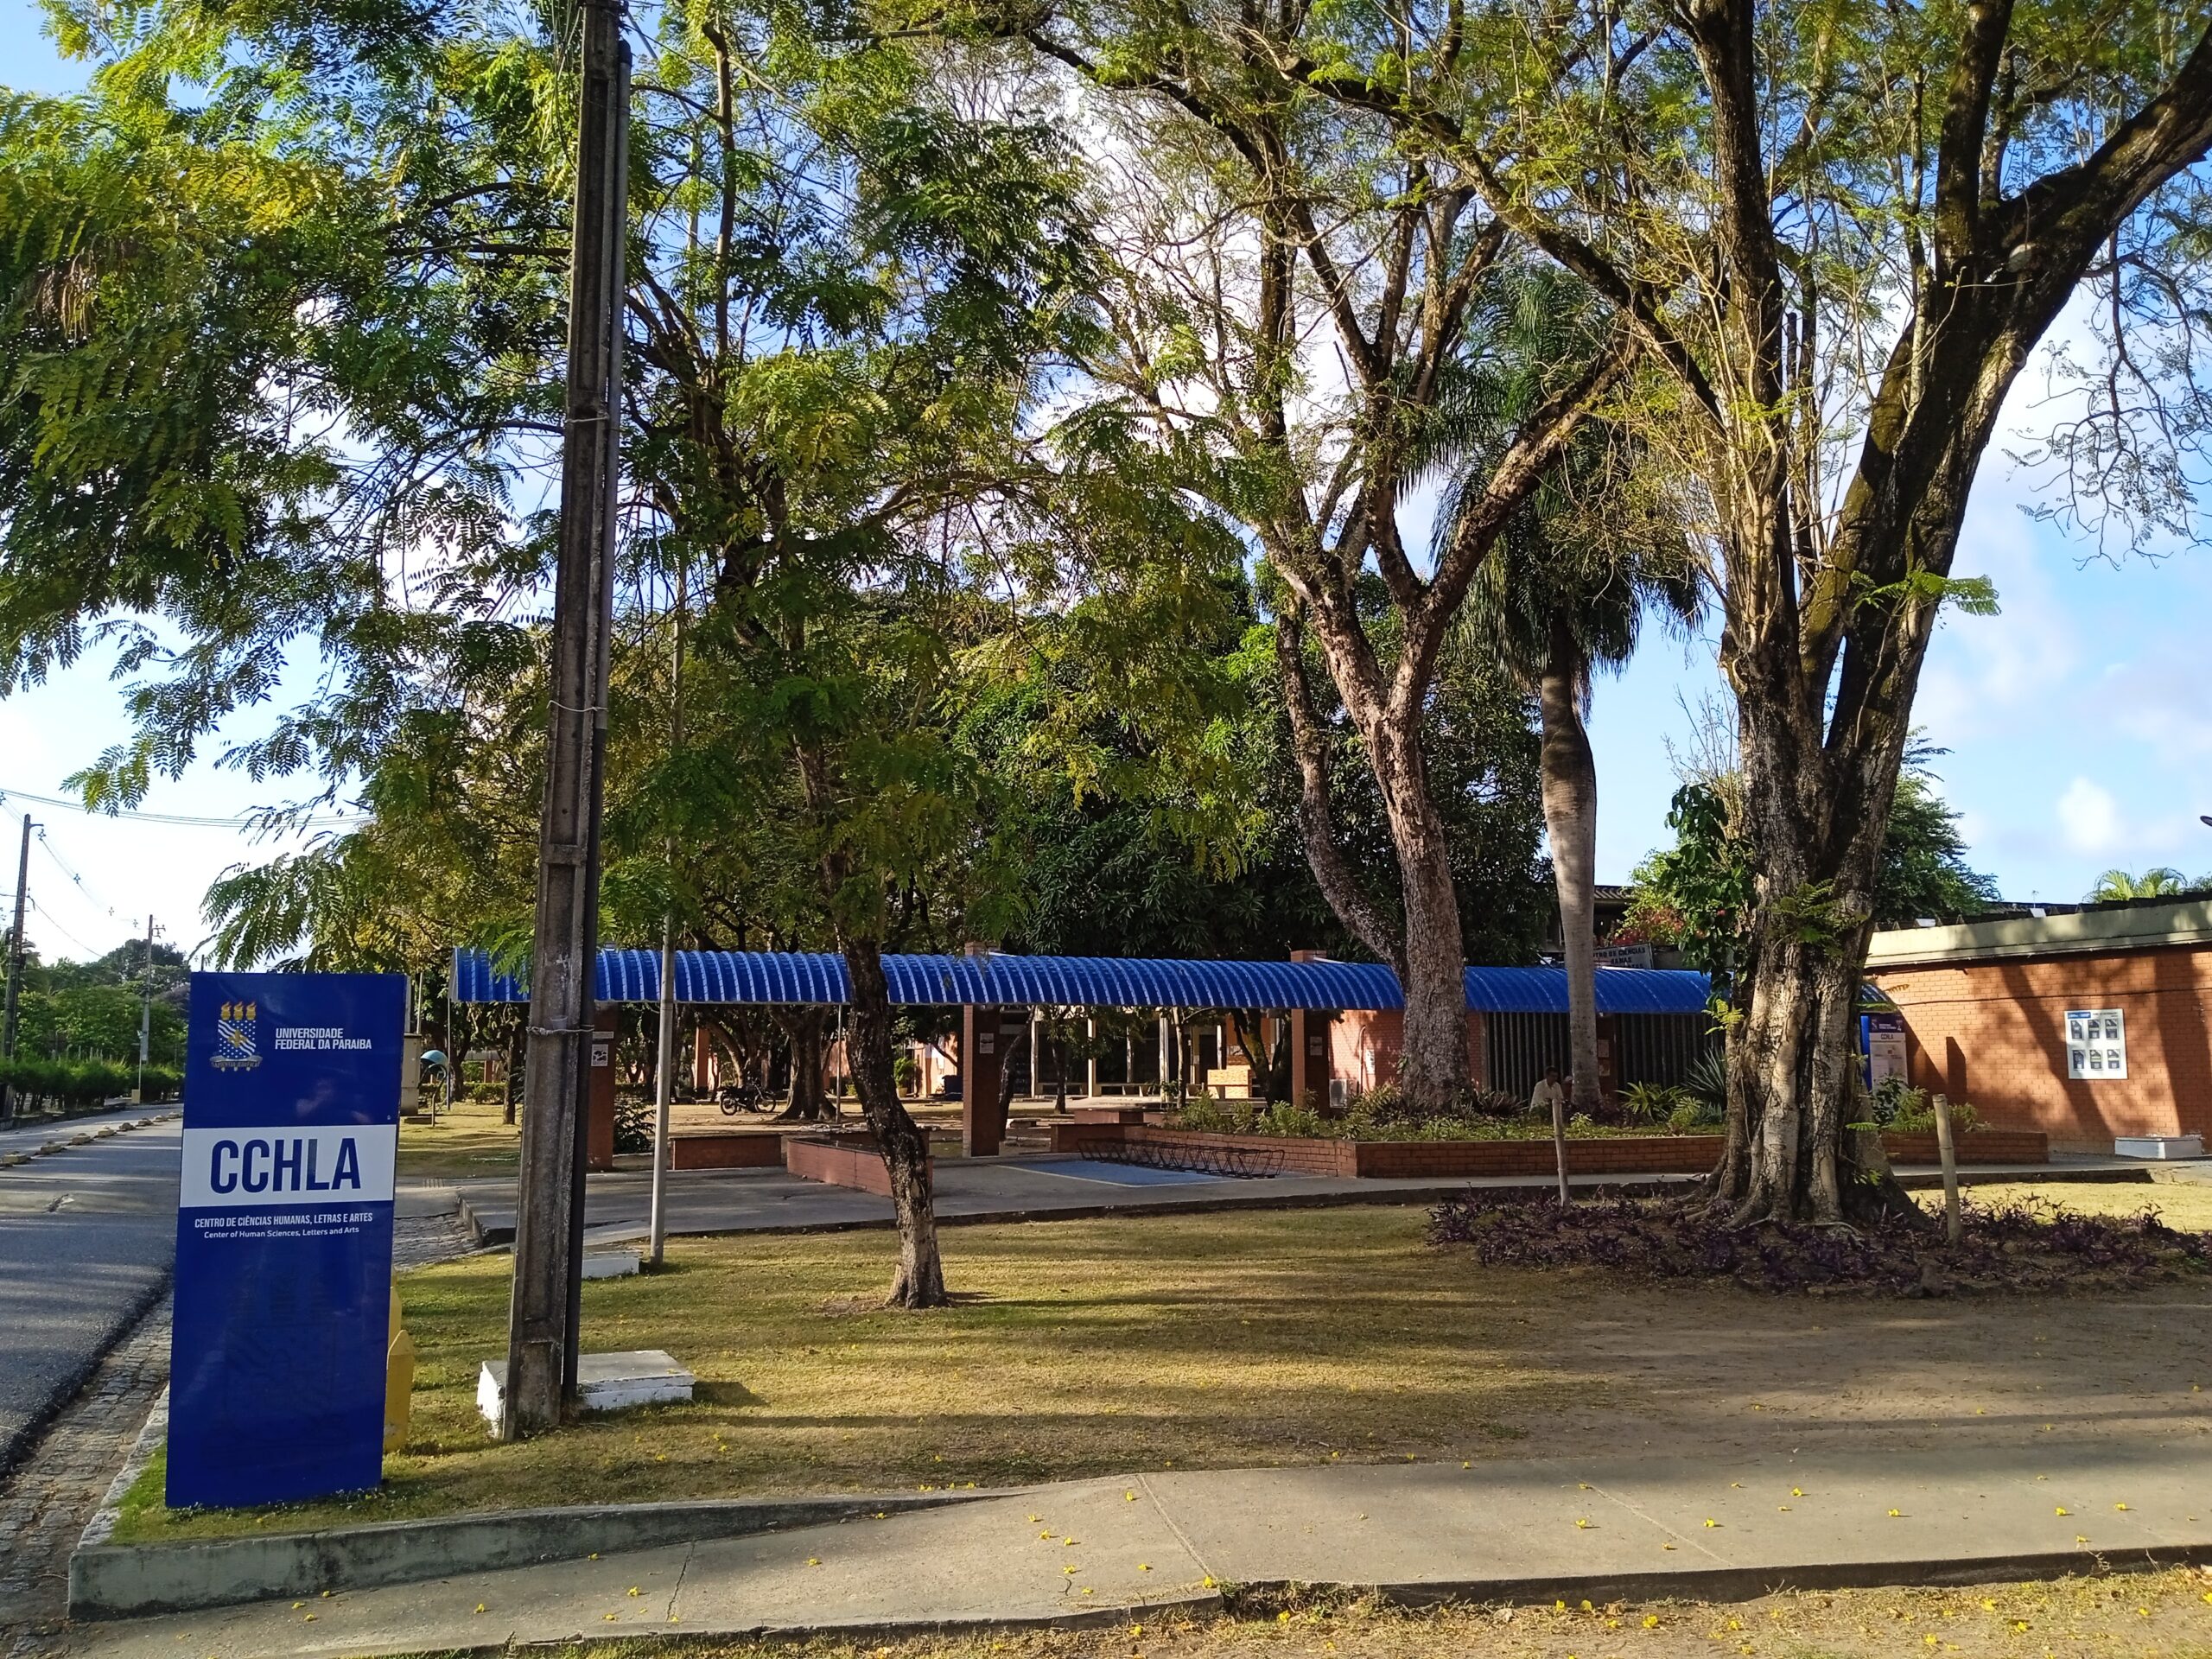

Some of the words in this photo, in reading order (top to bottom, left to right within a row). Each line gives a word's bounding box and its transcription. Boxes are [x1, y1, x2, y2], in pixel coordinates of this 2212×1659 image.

[276, 1027, 344, 1039] UNIVERSIDADE
[275, 1039, 316, 1050] FEDERAL
[318, 1039, 331, 1050] DA
[332, 1038, 372, 1050] PARAÍBA
[210, 1137, 361, 1194] CCHLA
[194, 1217, 225, 1228] CENTRO
[226, 1217, 237, 1227] DE
[238, 1215, 272, 1227] CIÊNCIAS
[273, 1214, 313, 1225] HUMANAS,
[314, 1213, 342, 1224] LETRAS
[343, 1213, 348, 1223] E
[349, 1212, 373, 1223] ARTES
[266, 1229, 302, 1237] Sciences,
[302, 1228, 328, 1236] Letters
